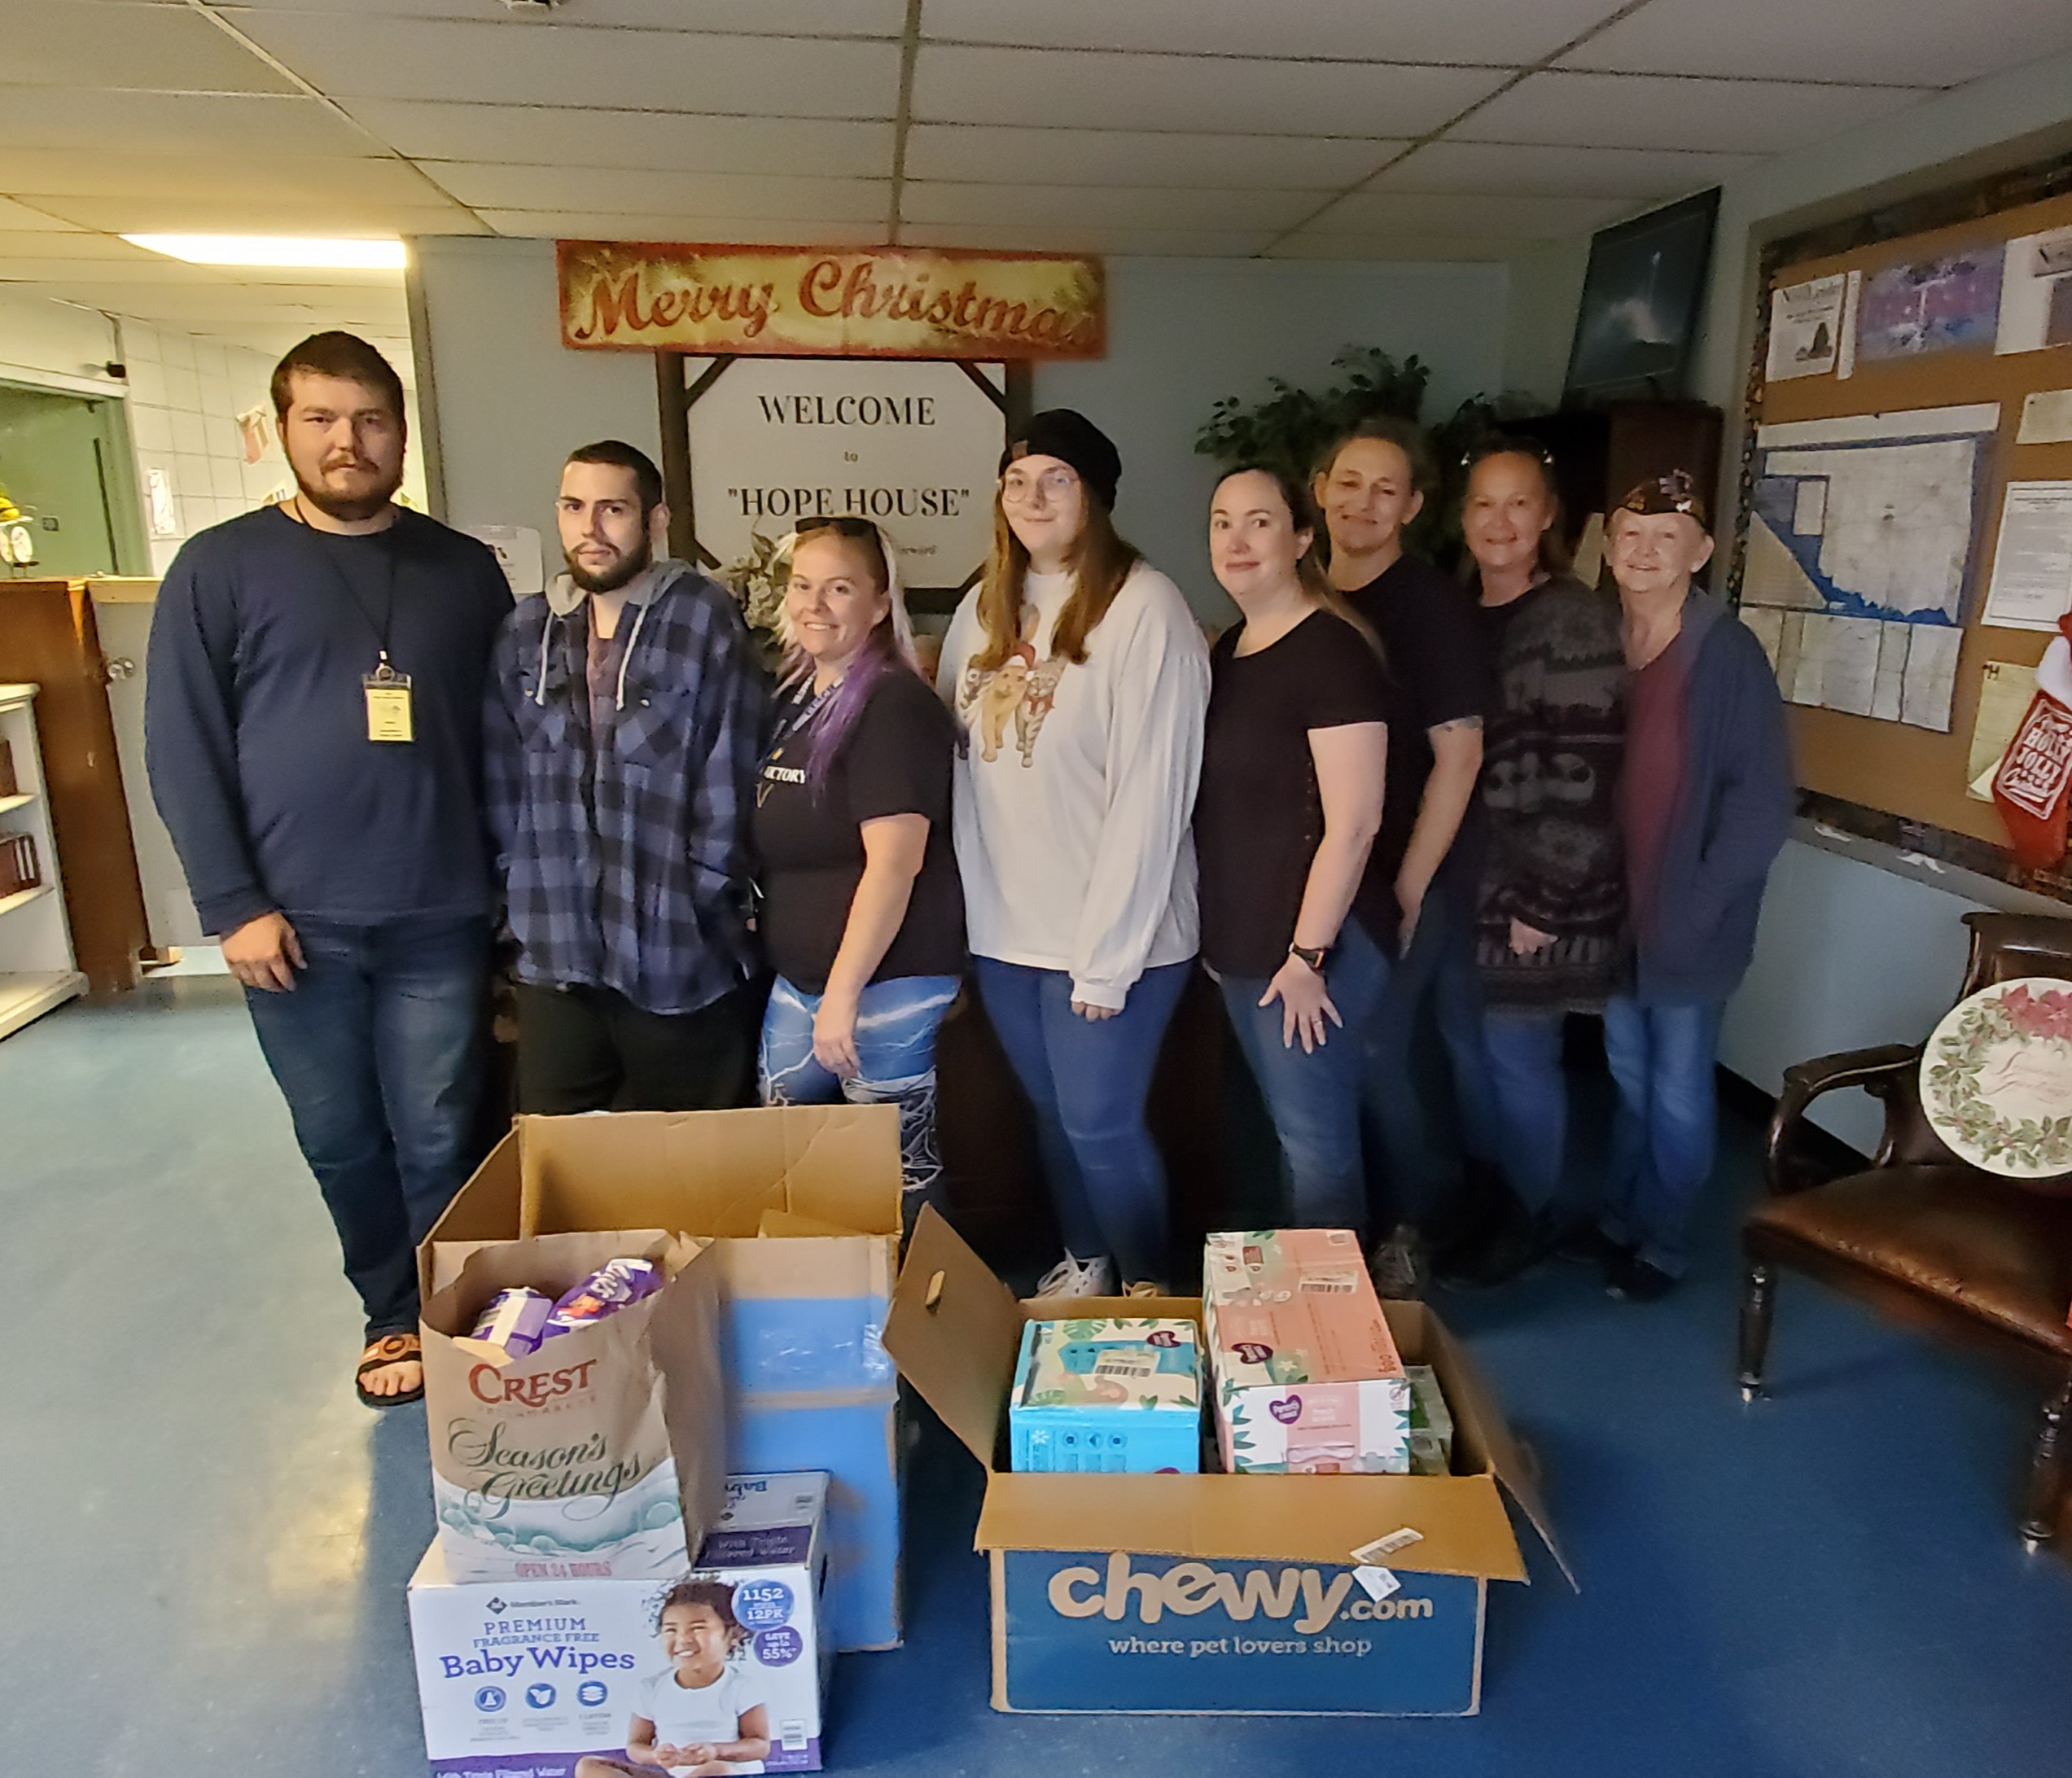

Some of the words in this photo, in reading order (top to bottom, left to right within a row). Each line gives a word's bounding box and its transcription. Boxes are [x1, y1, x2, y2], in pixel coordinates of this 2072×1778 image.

[573, 273, 773, 339] Merry
[756, 395, 935, 426] WELCOME
[843, 451, 859, 463] to
[728, 488, 834, 516] "HOPE
[843, 488, 970, 517] HOUSE"
[469, 1358, 598, 1408] CREST
[448, 1417, 607, 1470] Season's
[463, 1451, 641, 1522] Greetings
[743, 1588, 784, 1602] 1152
[484, 1618, 586, 1636] PREMIUM
[747, 1609, 784, 1621] 12PK
[473, 1634, 562, 1649] FRAGRANCE
[565, 1632, 600, 1643] FREE
[1109, 1636, 1185, 1653] where
[1190, 1637, 1227, 1658] pet
[1234, 1636, 1307, 1655] lovers
[1312, 1636, 1373, 1657] shop
[439, 1649, 524, 1678] Baby
[527, 1646, 636, 1675] Wipes
